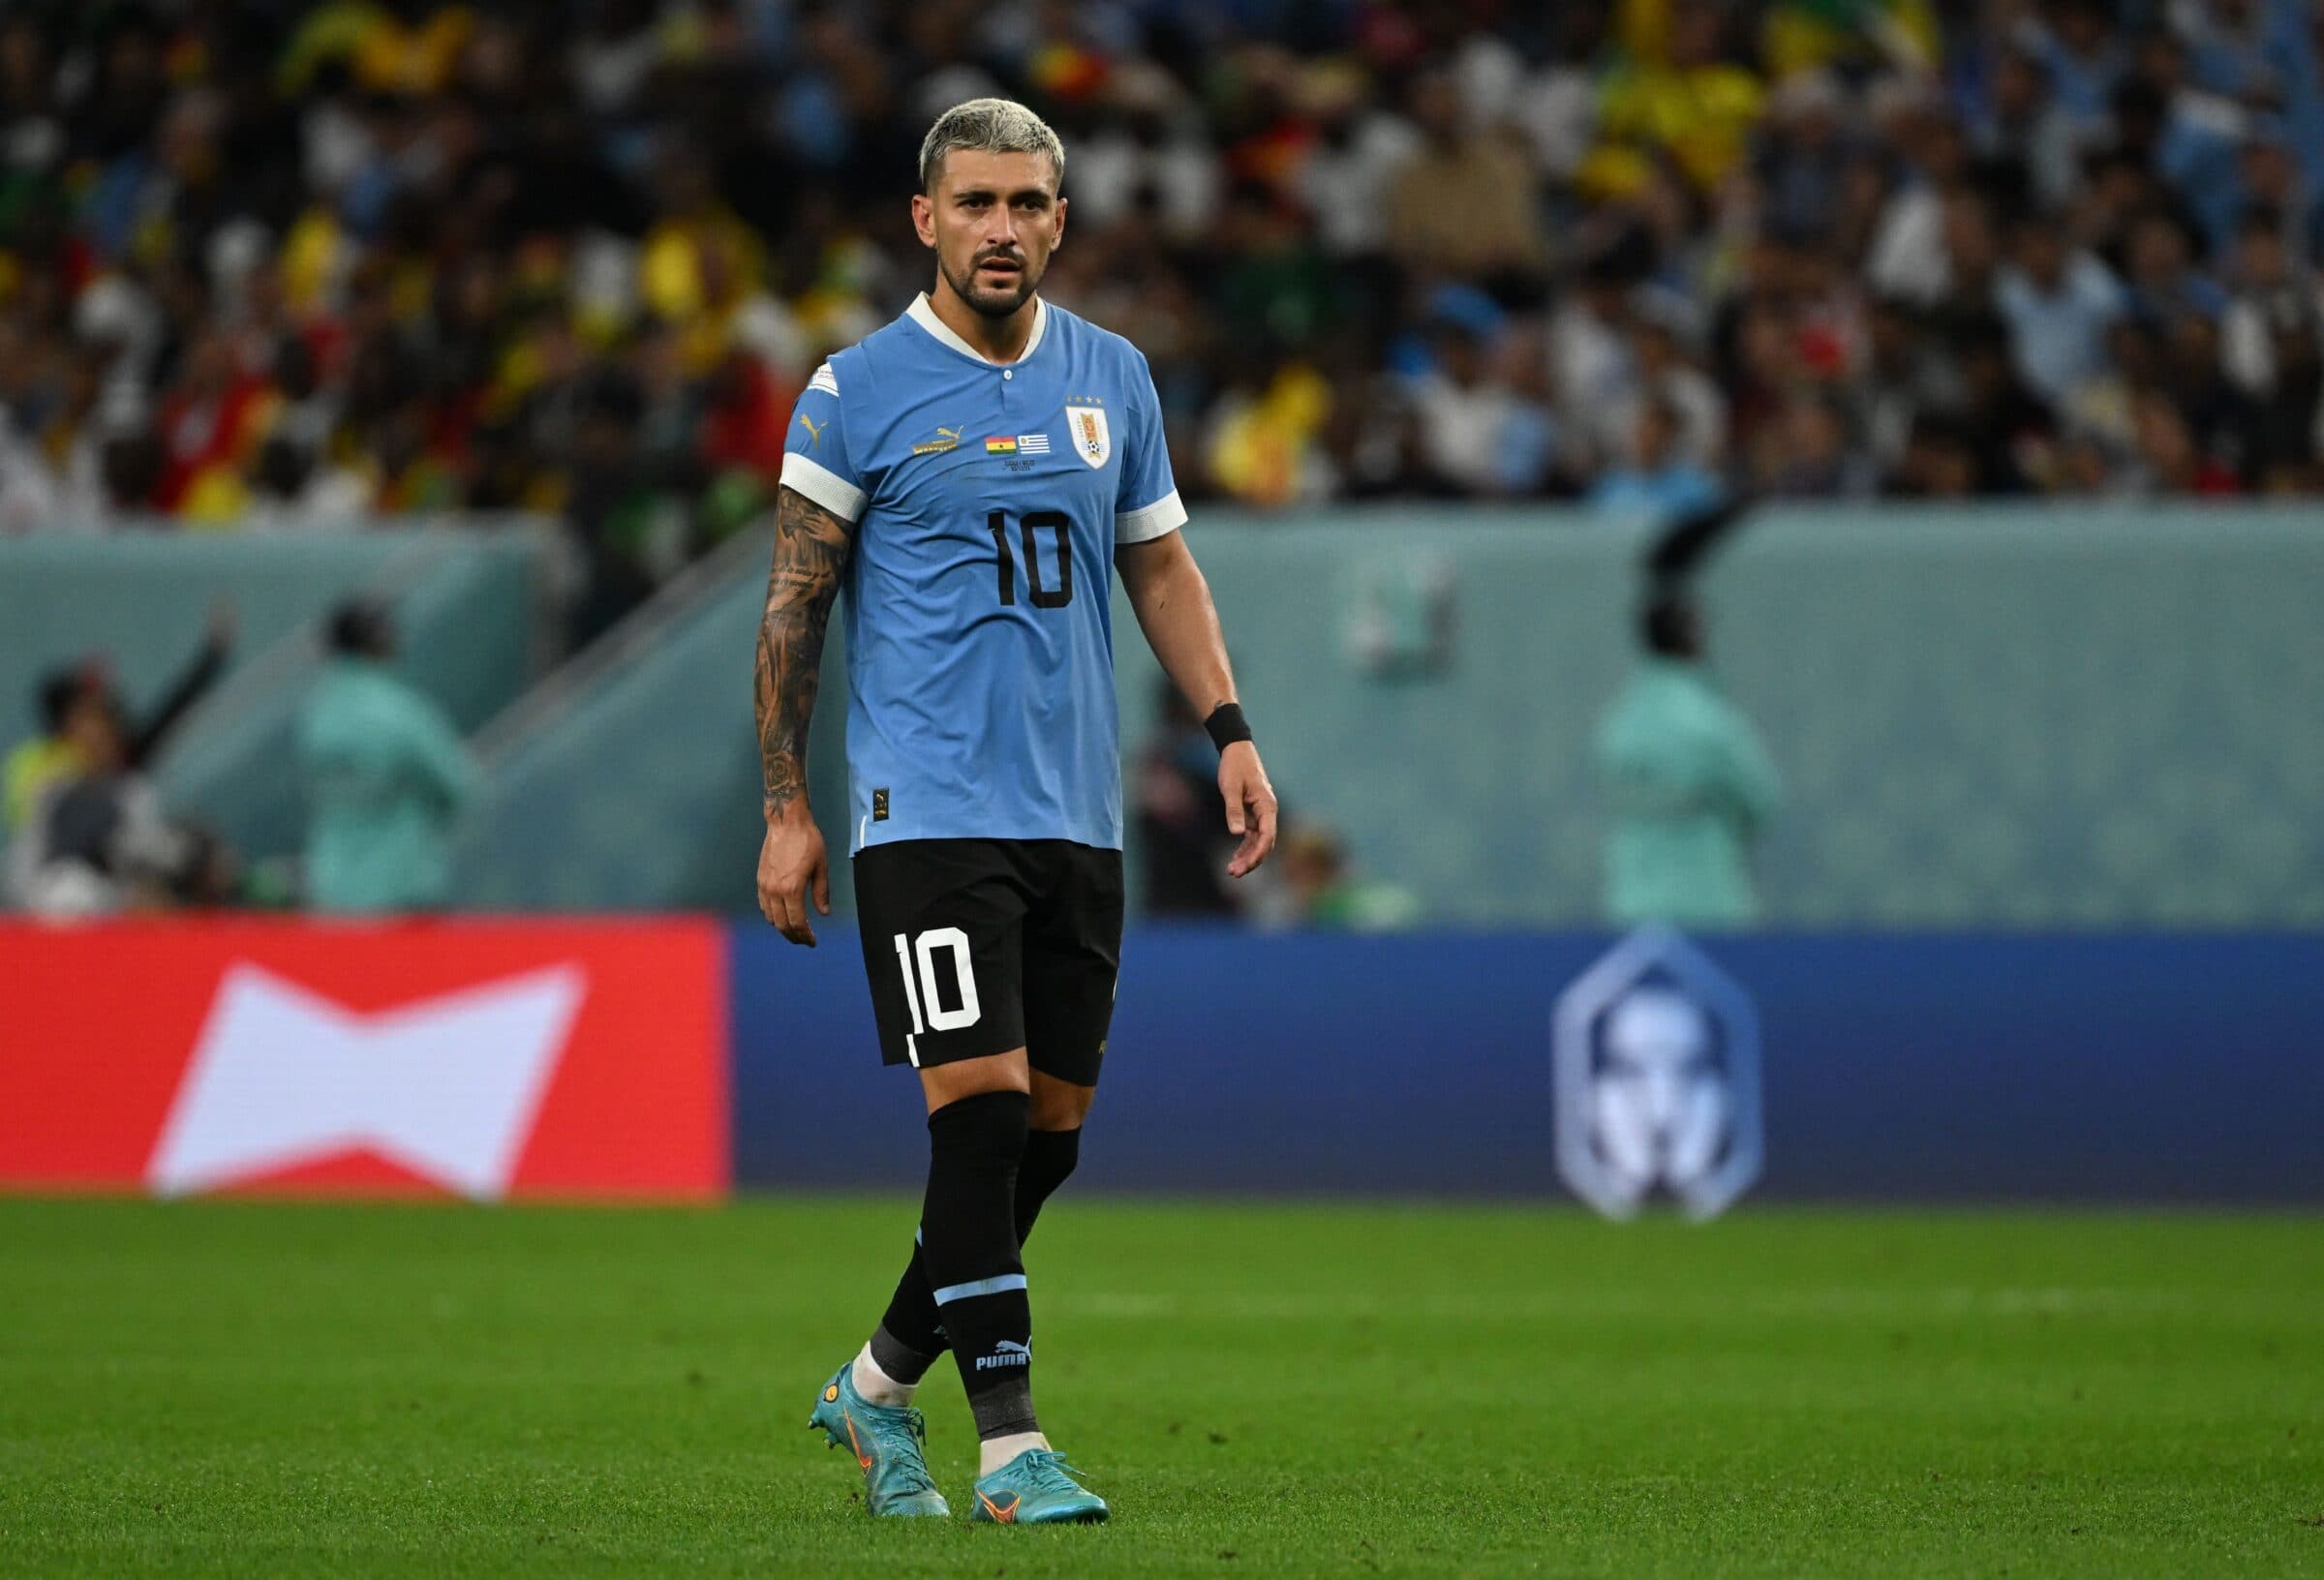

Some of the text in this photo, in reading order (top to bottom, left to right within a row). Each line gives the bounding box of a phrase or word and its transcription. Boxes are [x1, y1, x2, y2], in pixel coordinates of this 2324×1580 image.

[987, 512, 1073, 608] 10
[894, 927, 981, 1034] 10
[976, 1352, 1026, 1371] PUMA
